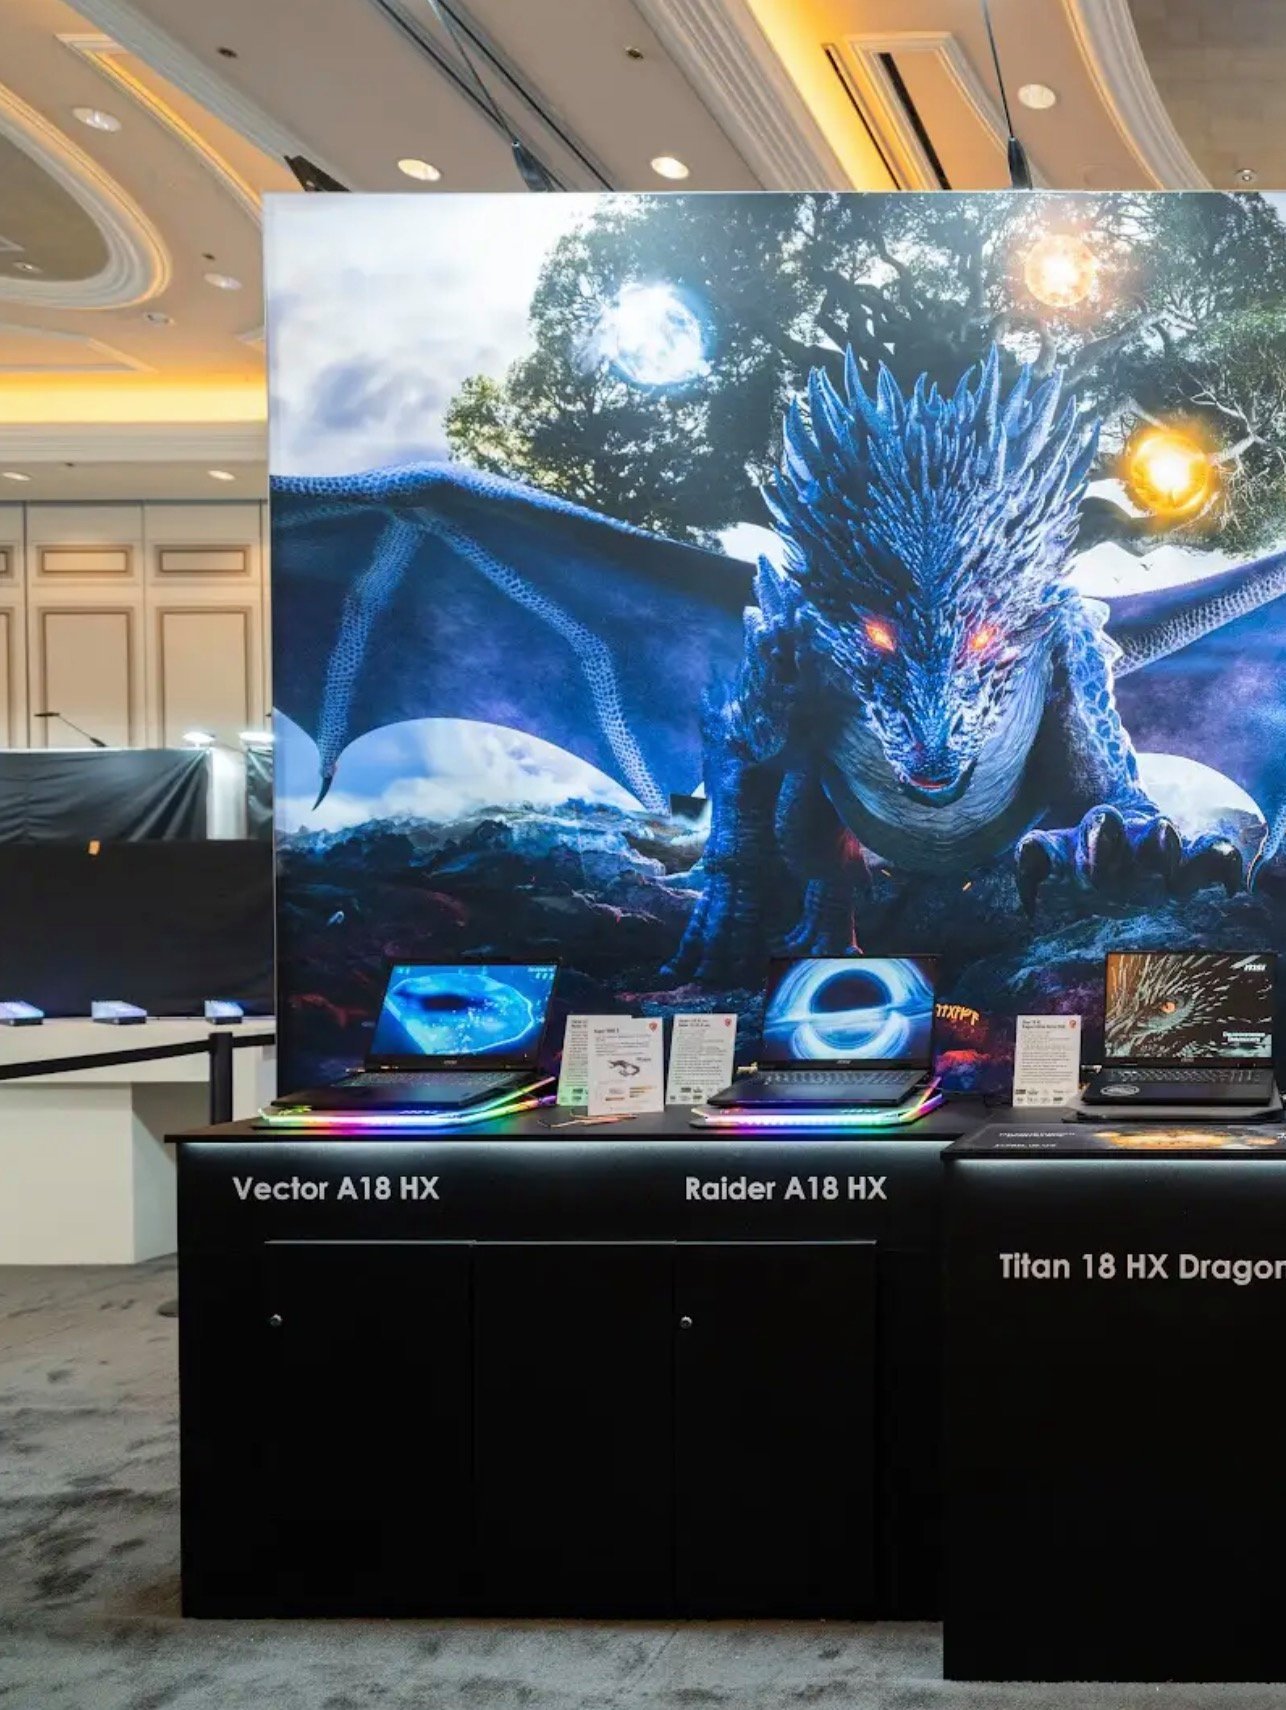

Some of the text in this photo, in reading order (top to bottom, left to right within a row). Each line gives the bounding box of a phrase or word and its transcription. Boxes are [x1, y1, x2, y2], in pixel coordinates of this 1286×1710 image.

[232, 1176, 440, 1200] Vector A18 HX
[685, 1176, 887, 1200] Raider A18 HX
[999, 1252, 1070, 1279] Titan
[1082, 1252, 1116, 1279] 18
[1127, 1253, 1169, 1279] HX
